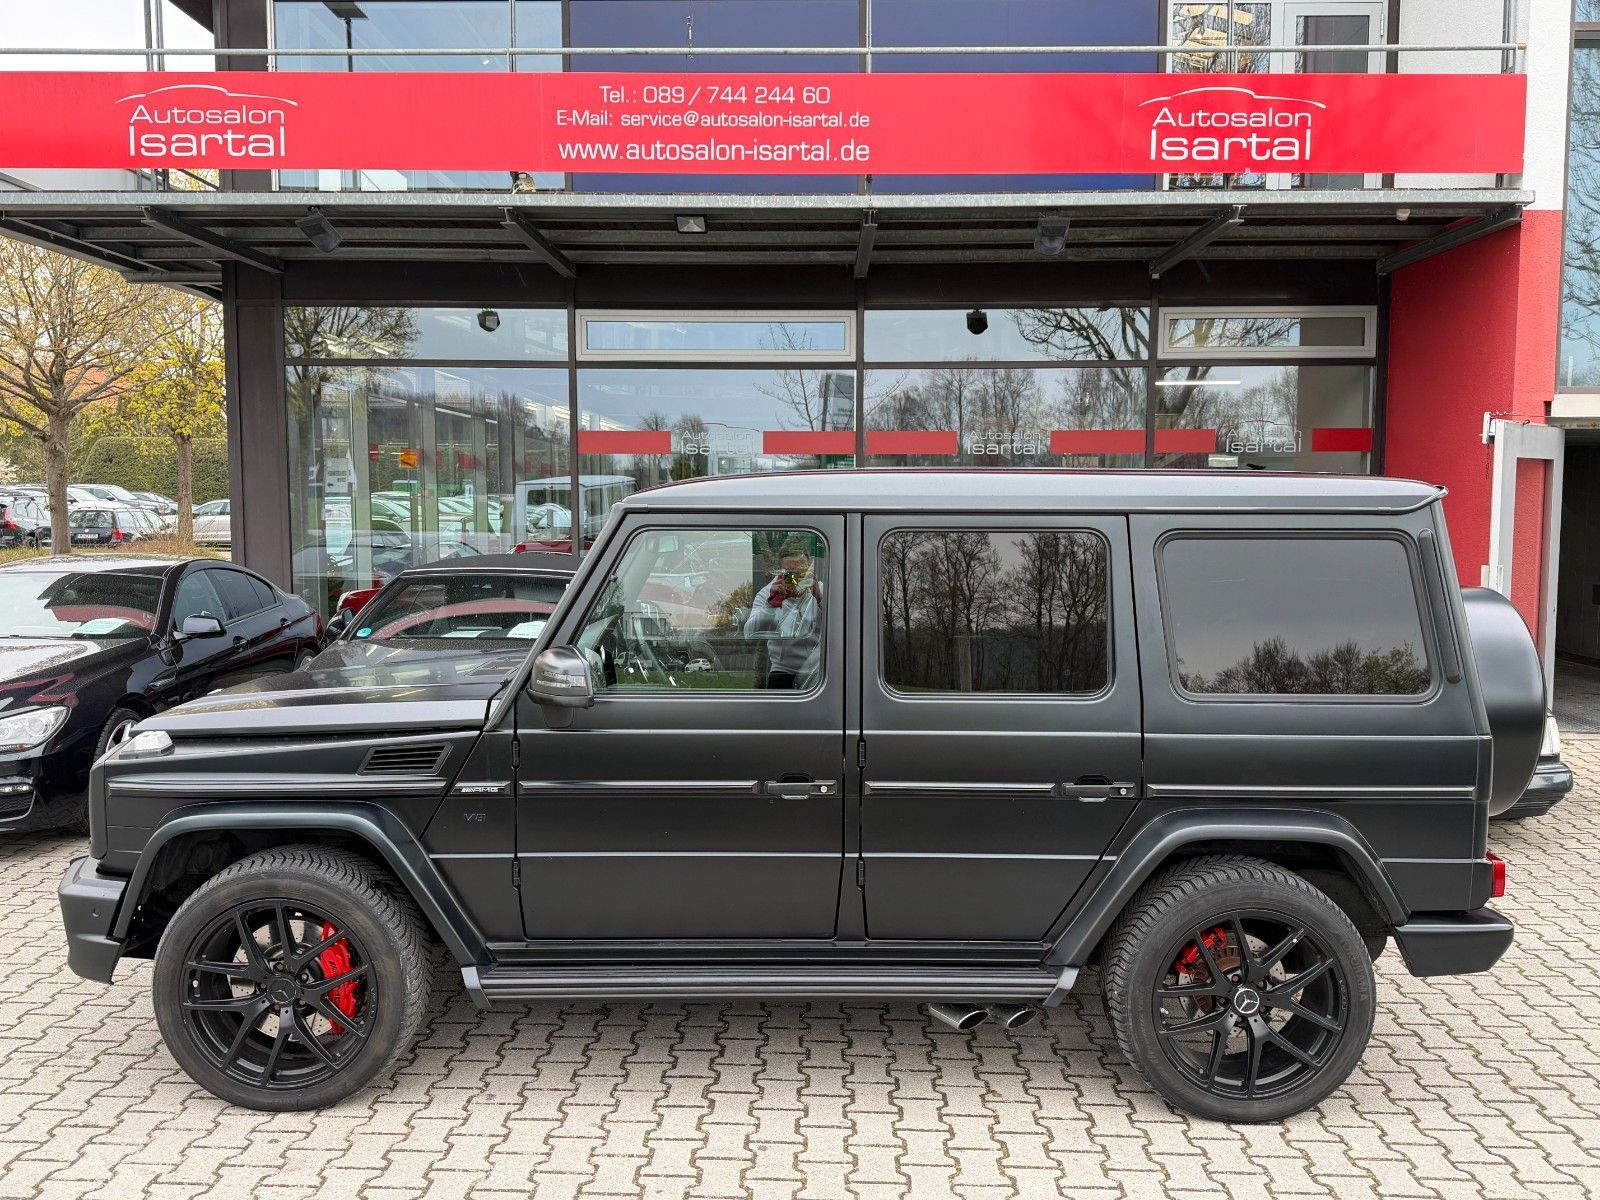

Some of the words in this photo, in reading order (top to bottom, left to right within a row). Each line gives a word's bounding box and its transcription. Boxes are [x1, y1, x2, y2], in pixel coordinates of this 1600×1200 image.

[599, 86, 636, 103] Tel.:
[644, 86, 684, 103] 089
[688, 87, 701, 105] /
[708, 86, 747, 103] 744
[755, 86, 795, 103] 244
[803, 87, 830, 104] 60
[130, 105, 284, 124] Autosalon
[557, 110, 612, 125] E-Mail:
[621, 111, 869, 127] service@autosalon-isartal.de
[1153, 108, 1311, 127] Autosalon
[129, 126, 285, 156] Isartal
[559, 138, 869, 161] www.autosalon-isartal.de
[1151, 129, 1311, 160] Isartal
[969, 430, 1041, 440] Autosalon
[680, 440, 753, 455] Isatal
[967, 439, 1041, 455] Isartal
[1225, 437, 1302, 453] Isartal
